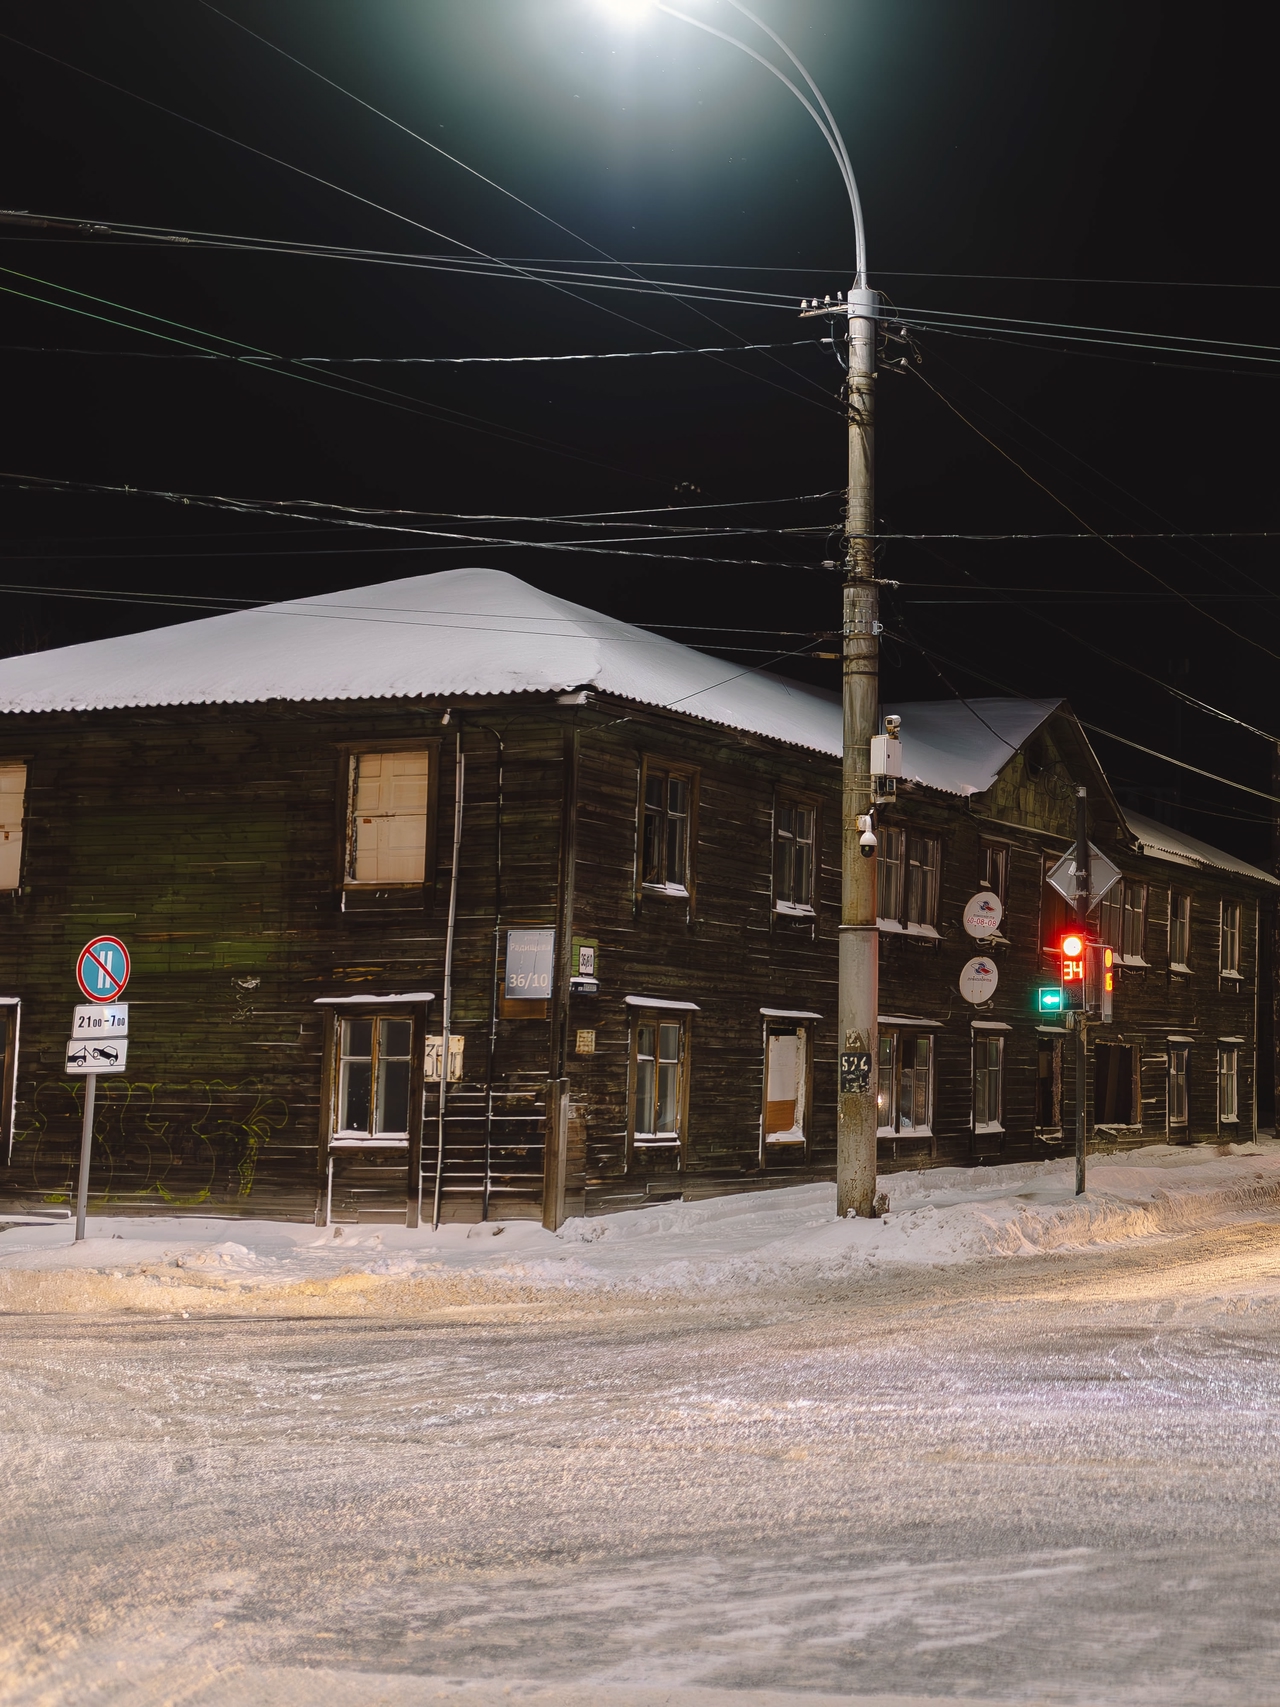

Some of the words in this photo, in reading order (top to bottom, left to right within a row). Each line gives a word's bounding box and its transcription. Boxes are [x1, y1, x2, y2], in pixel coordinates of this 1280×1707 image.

[967, 917, 997, 927] 60-08-08
[1063, 961, 1083, 980] 34
[508, 972, 549, 990] 36/10
[1105, 972, 1113, 991] 6
